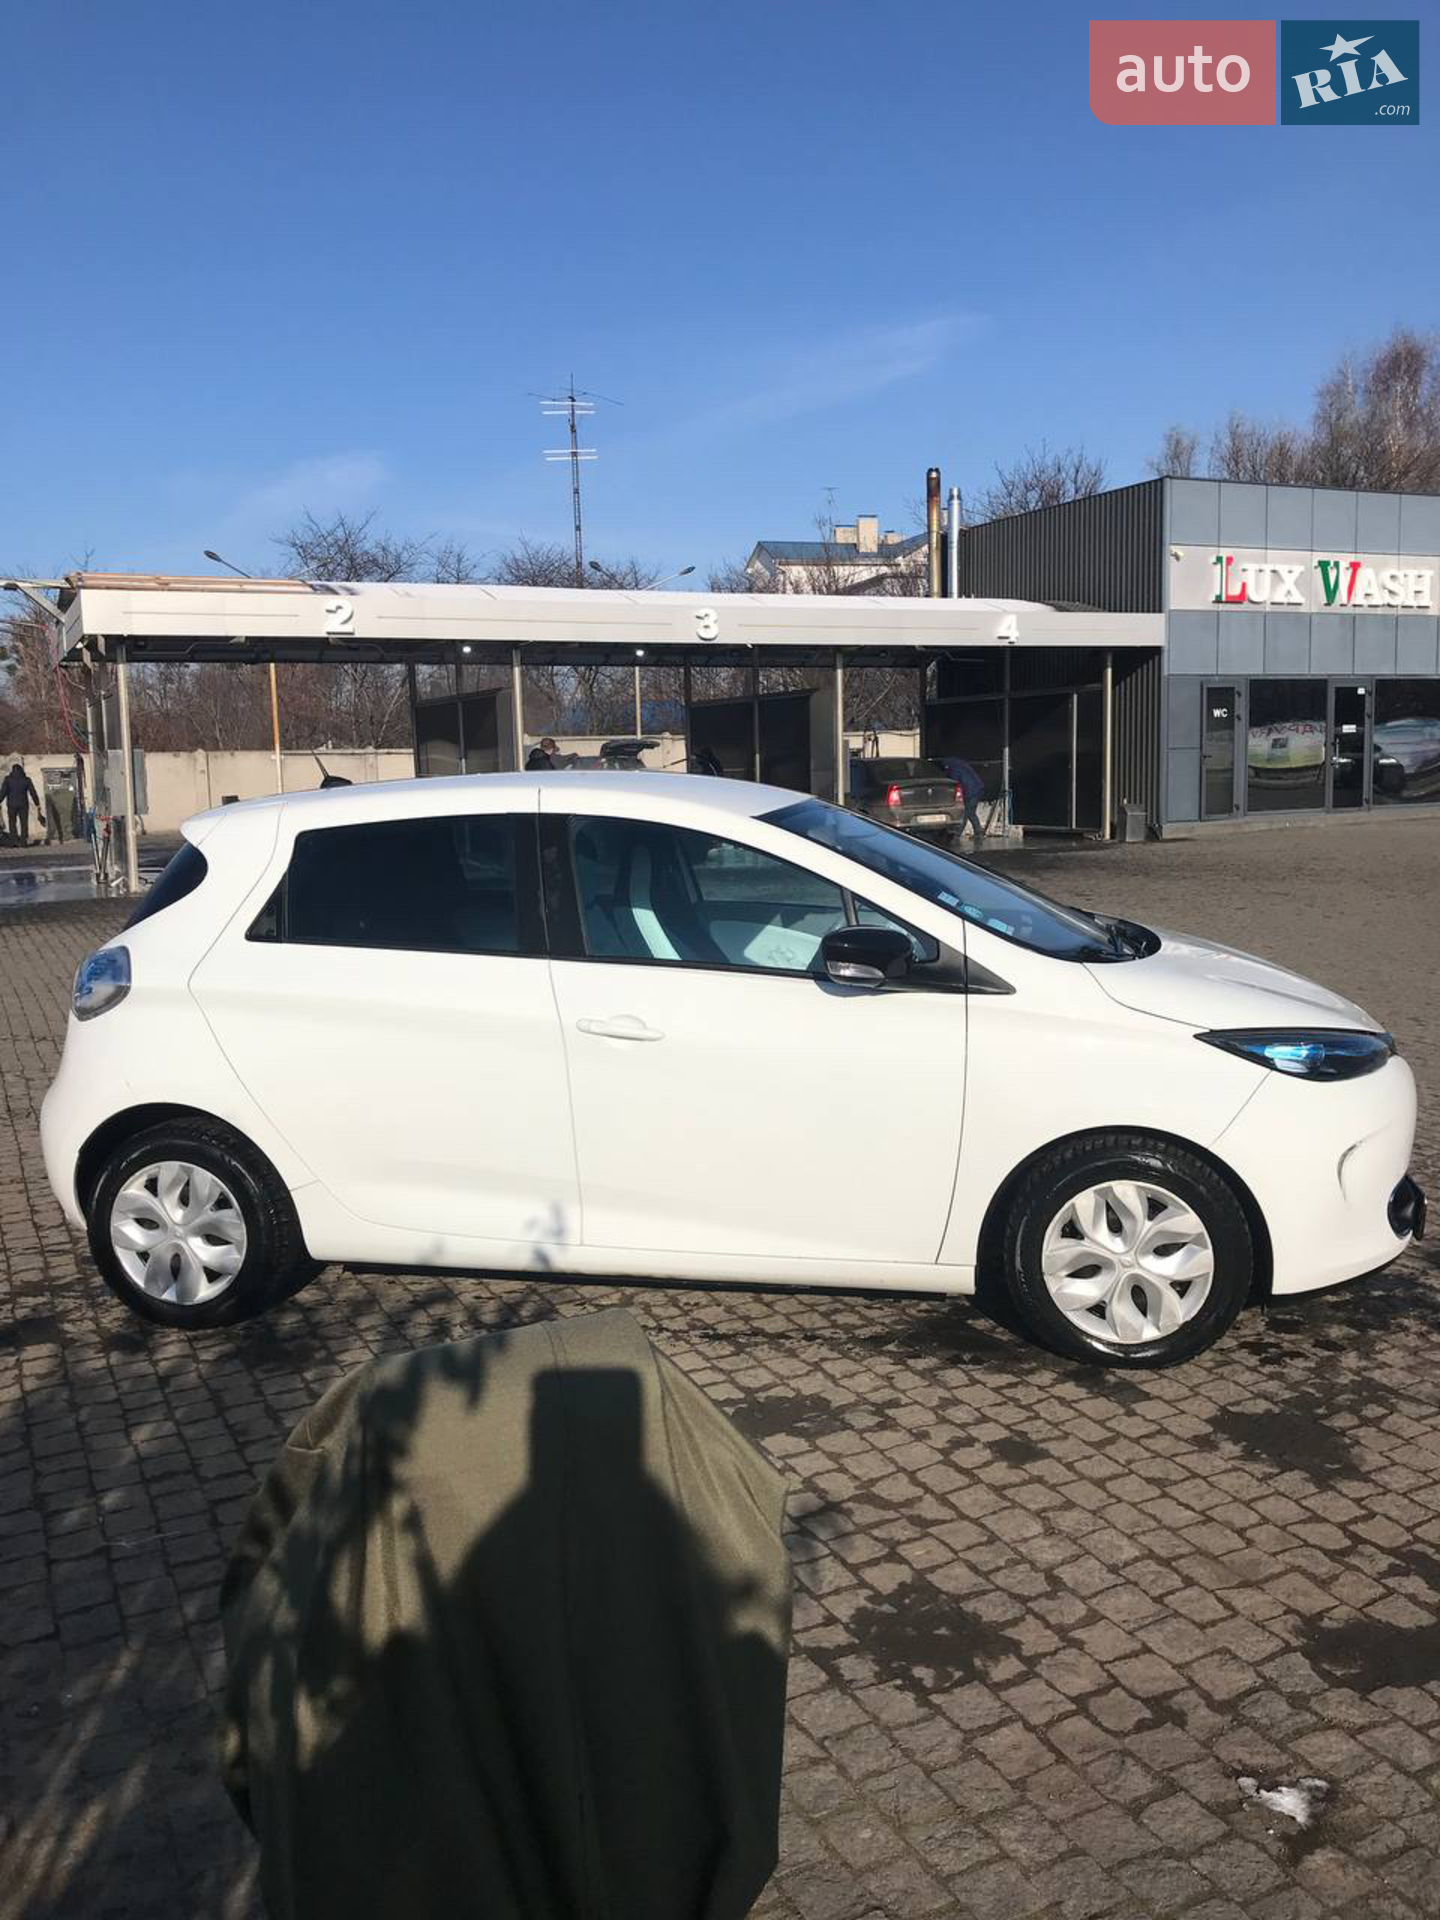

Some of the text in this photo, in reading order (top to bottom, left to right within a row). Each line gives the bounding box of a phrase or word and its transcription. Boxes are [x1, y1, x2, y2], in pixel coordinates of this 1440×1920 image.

[1212, 555, 1434, 609] LUX WASH
[325, 599, 355, 635] 2
[695, 608, 720, 641] 3
[996, 613, 1019, 644] 4
[1212, 707, 1228, 718] WC
